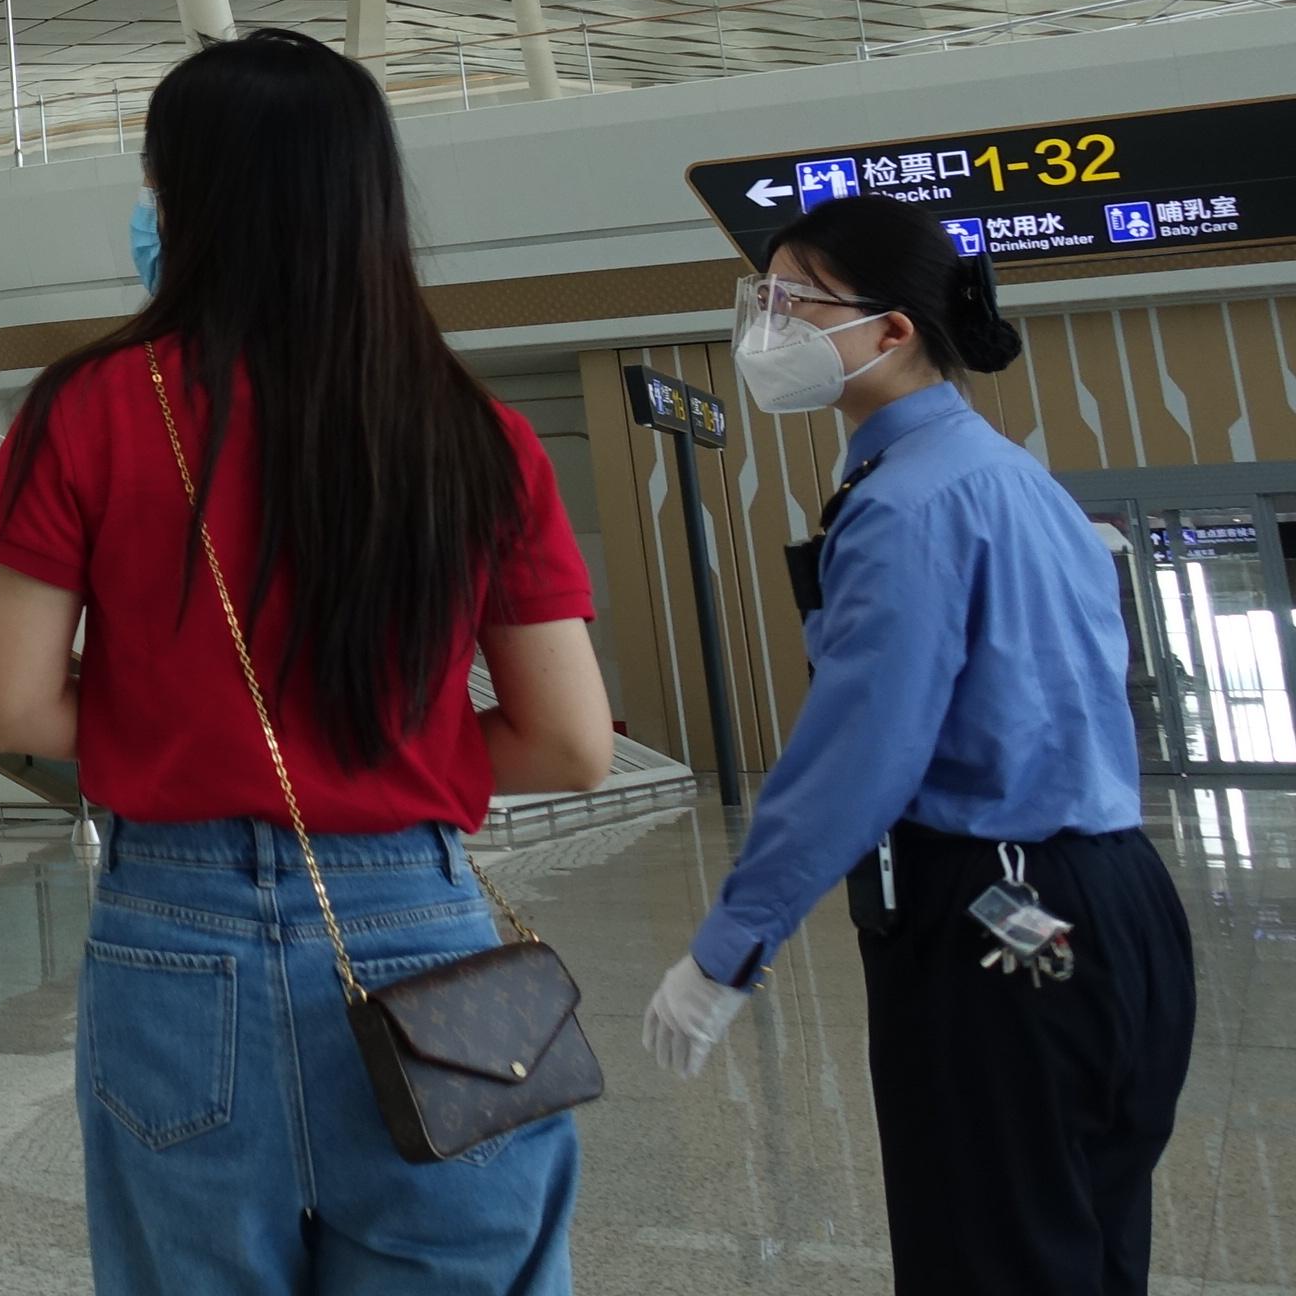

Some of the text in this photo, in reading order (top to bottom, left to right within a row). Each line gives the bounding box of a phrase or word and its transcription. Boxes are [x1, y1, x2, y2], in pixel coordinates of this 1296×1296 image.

[862, 133, 1120, 192] 检票口 1-32
[868, 185, 952, 203] eck in
[1157, 196, 1240, 224] 哺乳室
[986, 212, 1064, 239] 饮用水
[1159, 220, 1238, 238] Baby Care
[990, 234, 1094, 254] Drinking Water
